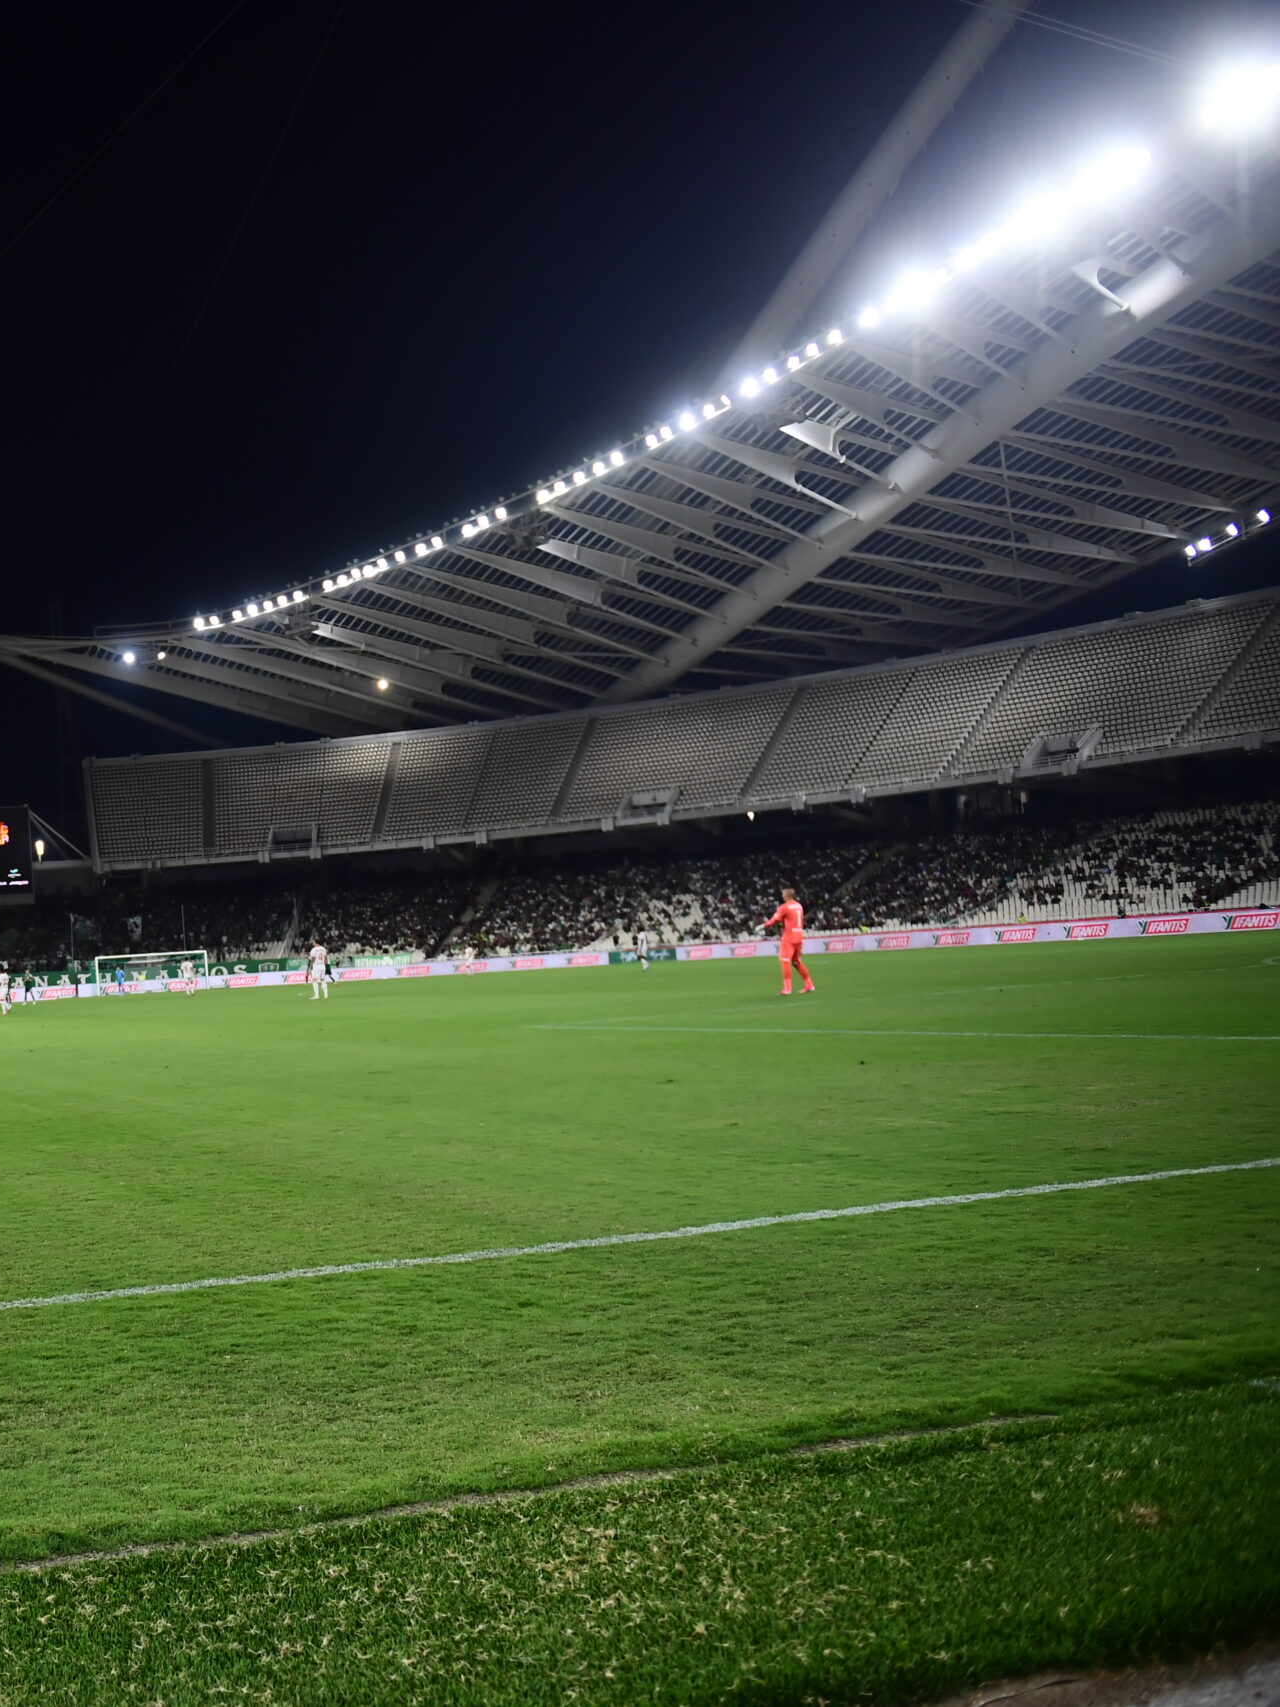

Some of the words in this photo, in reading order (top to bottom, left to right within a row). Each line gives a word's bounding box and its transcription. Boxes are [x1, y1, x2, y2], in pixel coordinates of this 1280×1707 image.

[1148, 920, 1186, 933] IFANTIS
[1233, 914, 1276, 929] IFANTIS
[1003, 930, 1034, 941] IFANTIS
[1072, 925, 1107, 938] IFANTIS
